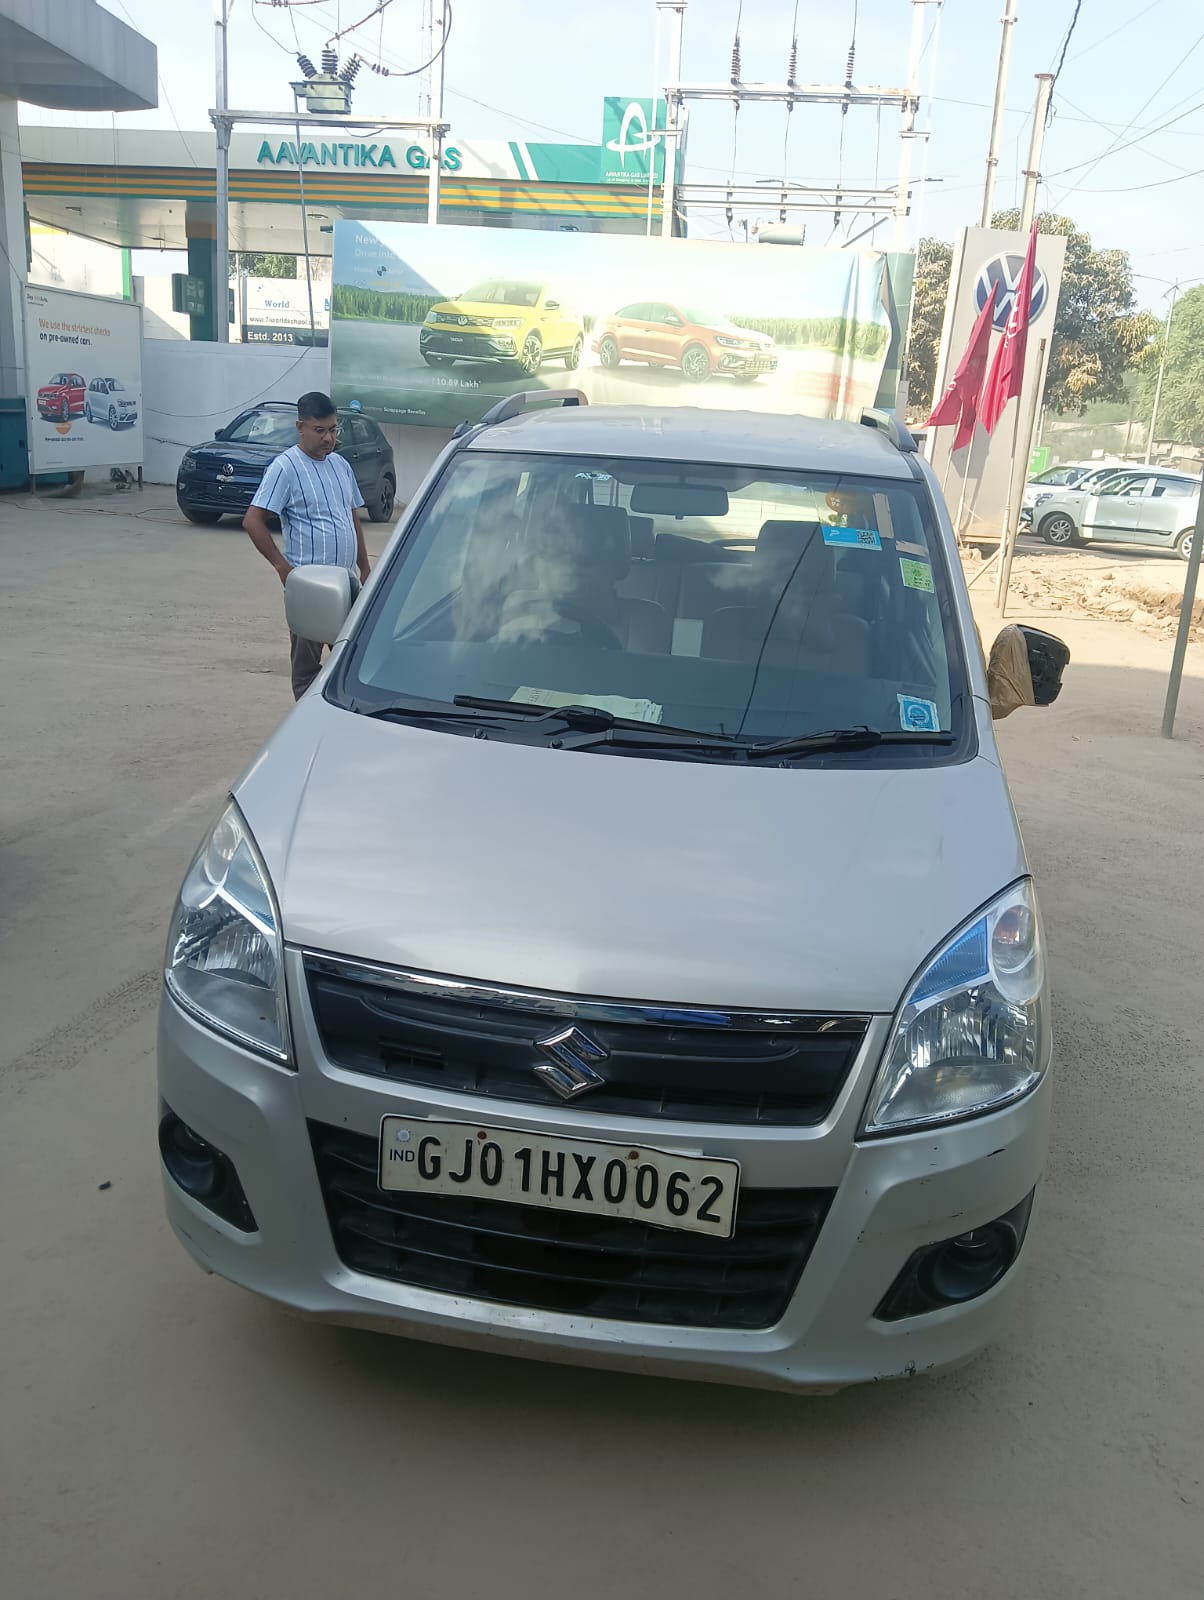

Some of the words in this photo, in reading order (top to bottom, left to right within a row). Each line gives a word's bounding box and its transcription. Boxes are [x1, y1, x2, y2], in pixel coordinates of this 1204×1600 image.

[257, 140, 396, 168] AAVANTIKA
[264, 299, 290, 308] World
[39, 332, 48, 341] on
[48, 333, 79, 345] pre-owned
[247, 331, 270, 341] Estd.
[272, 333, 293, 342] 2013
[389, 1148, 415, 1162] IND
[417, 1136, 725, 1223] GJ01HX0062
